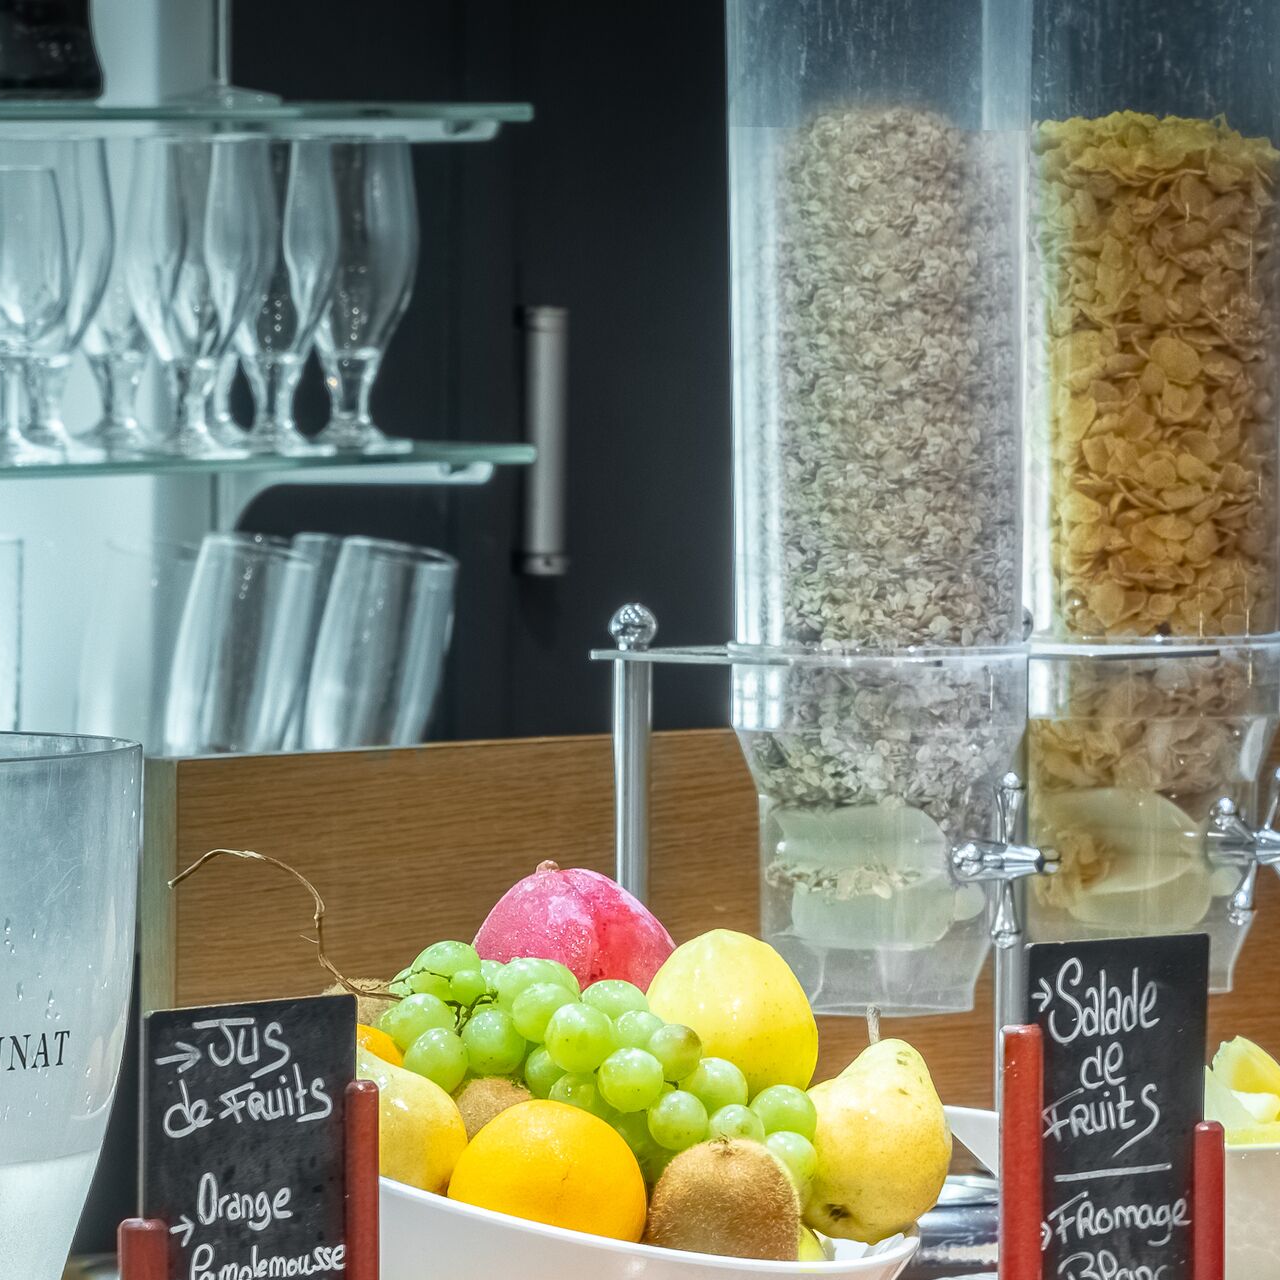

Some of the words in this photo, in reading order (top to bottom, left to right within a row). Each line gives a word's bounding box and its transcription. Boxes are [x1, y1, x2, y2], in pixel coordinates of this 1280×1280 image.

[1048, 957, 1160, 1044] Salade
[1080, 1041, 1127, 1090] de
[163, 1079, 215, 1139] de
[197, 1172, 294, 1231] Orange
